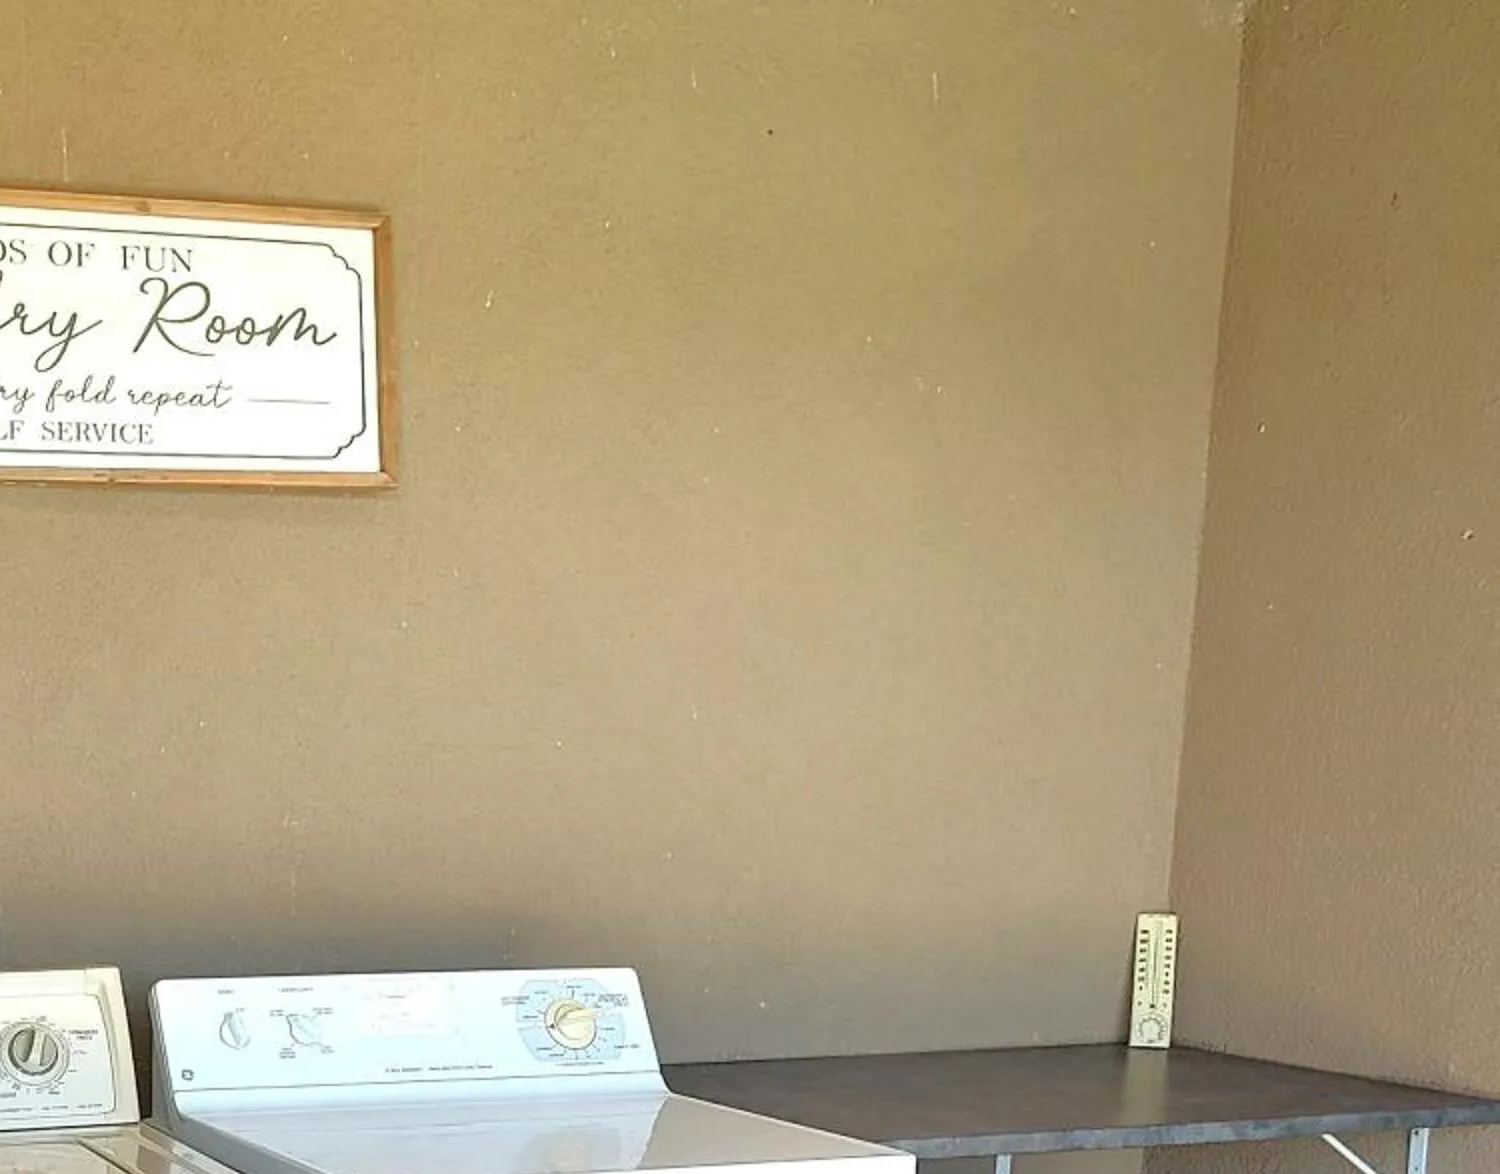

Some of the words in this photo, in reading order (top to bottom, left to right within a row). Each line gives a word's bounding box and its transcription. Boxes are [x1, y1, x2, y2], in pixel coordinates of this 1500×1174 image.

[47, 241, 95, 268] OF
[121, 244, 193, 273] FUN
[132, 276, 337, 357] Room
[45, 373, 117, 412] fold
[127, 378, 232, 414] repeat
[41, 421, 154, 444] SERVICE
